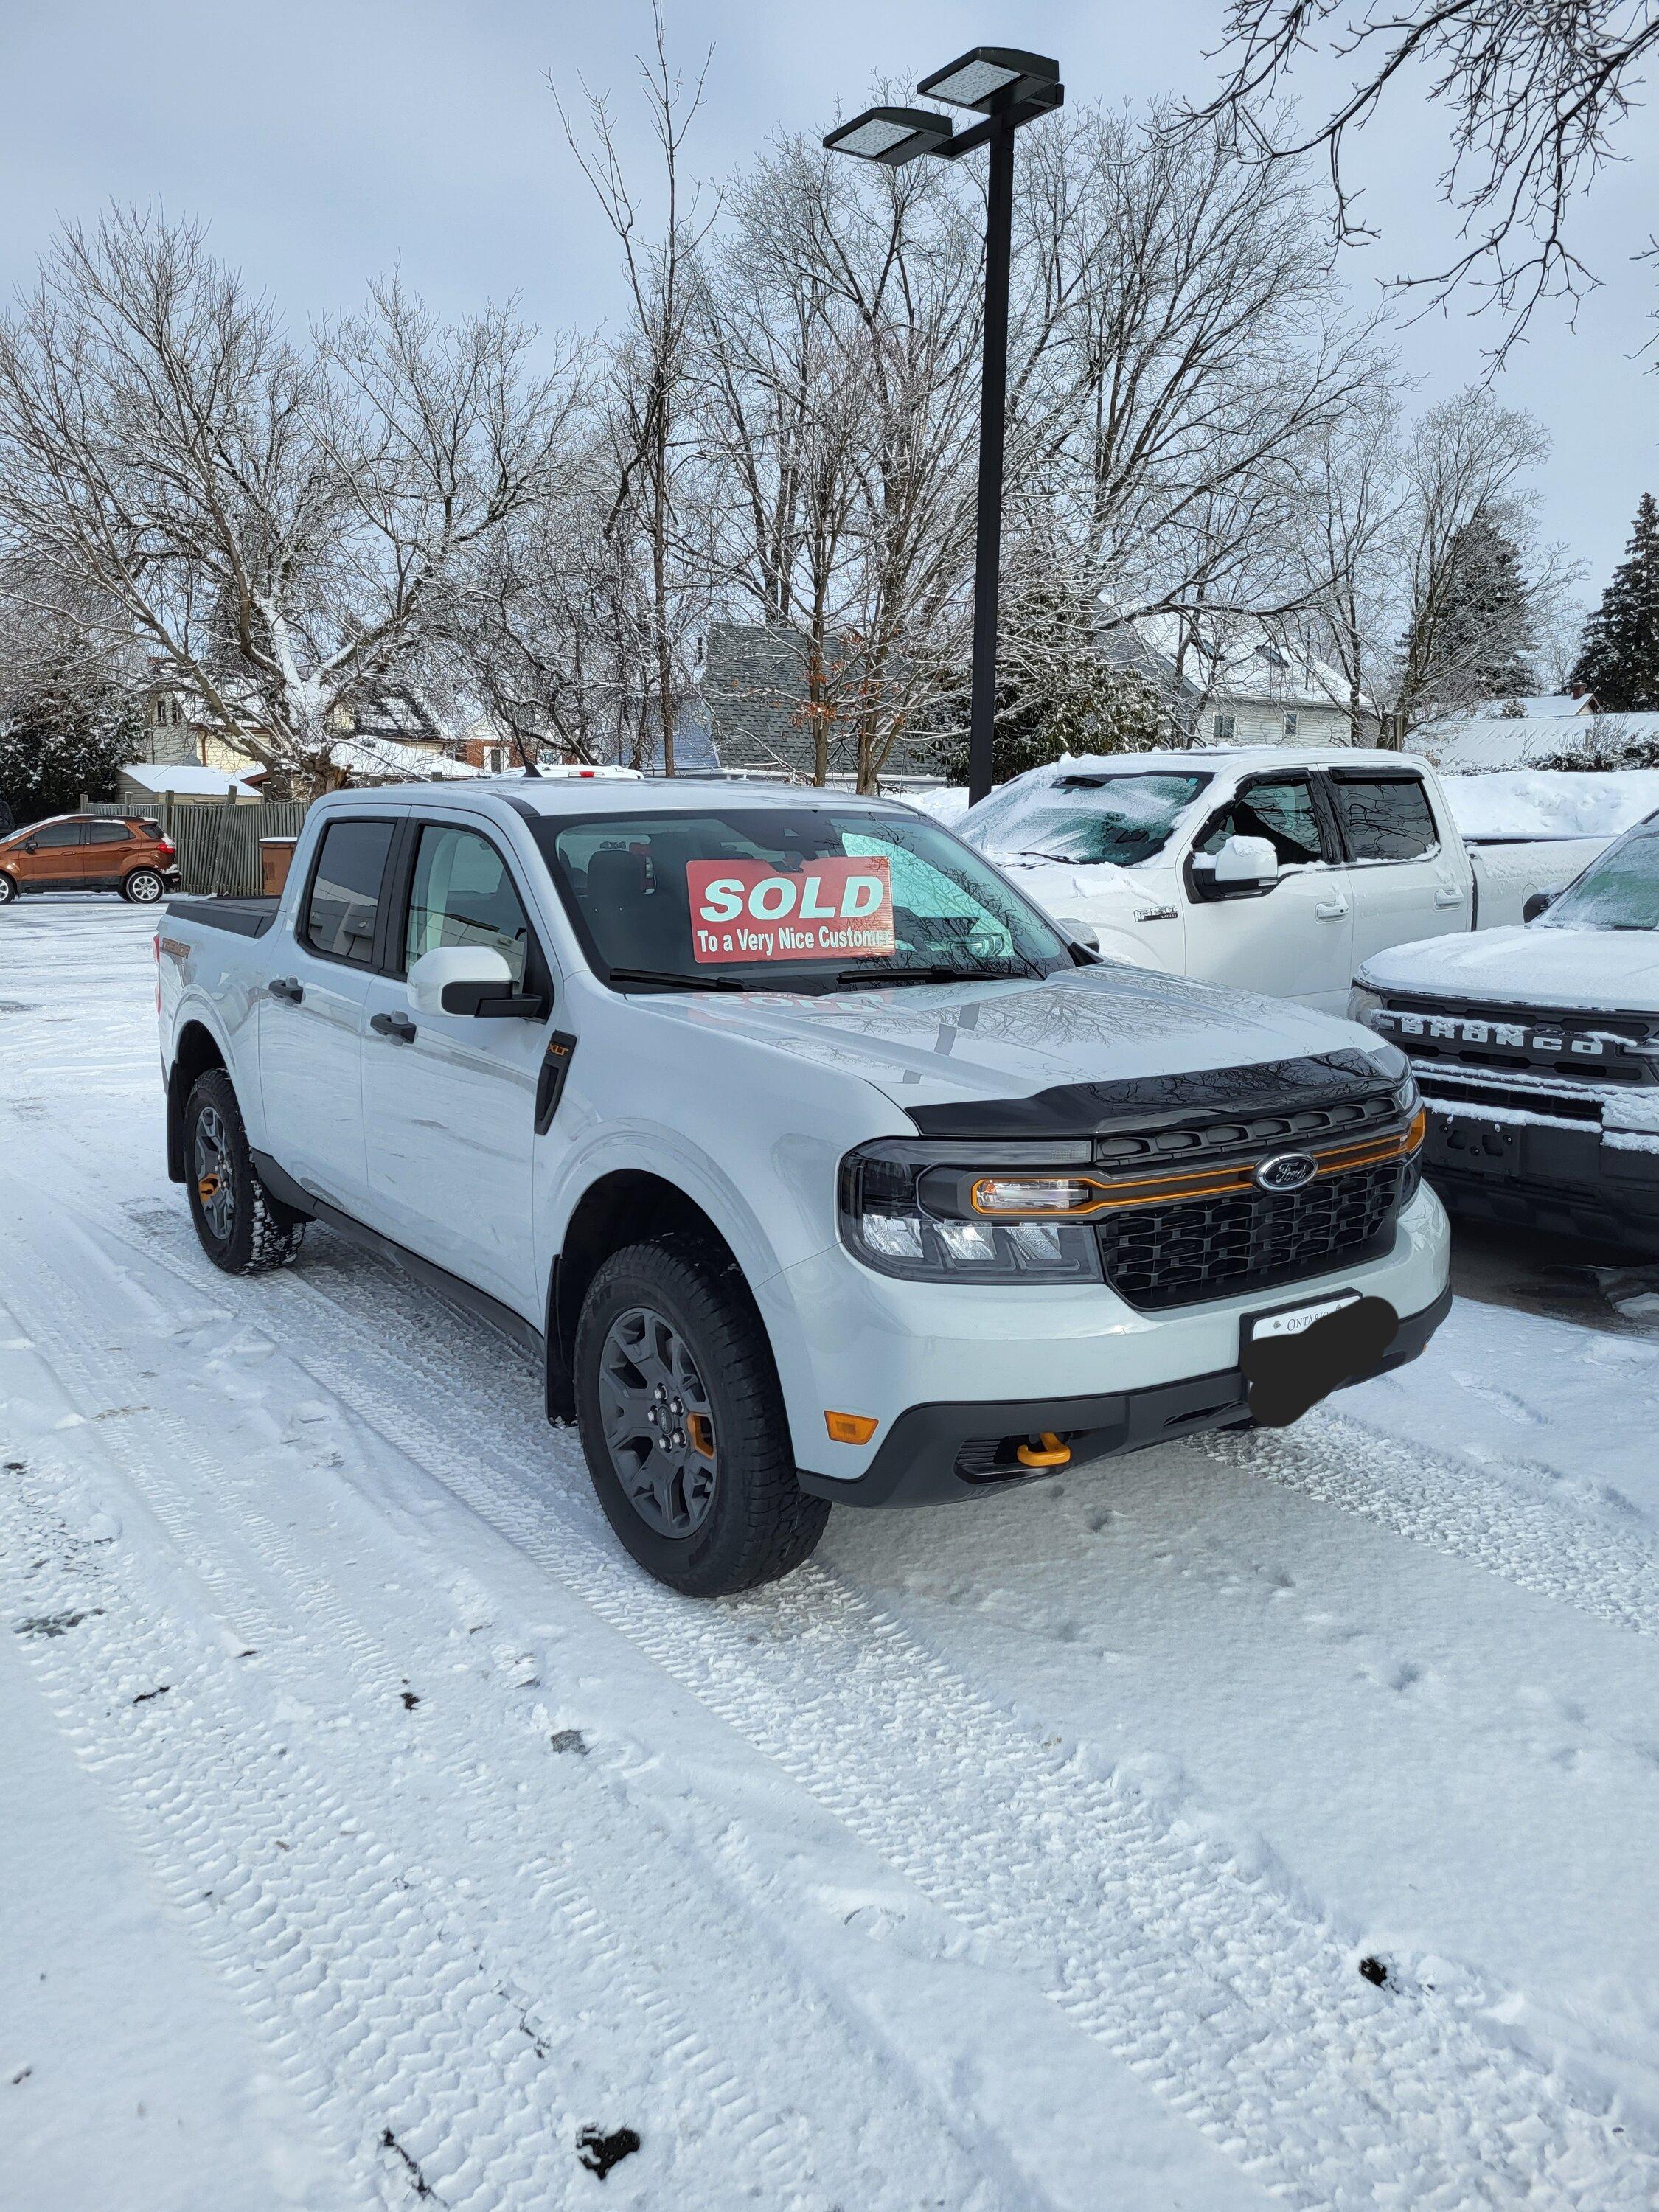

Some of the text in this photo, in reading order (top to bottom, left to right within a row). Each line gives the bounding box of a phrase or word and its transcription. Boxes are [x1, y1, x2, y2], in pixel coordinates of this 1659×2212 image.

[700, 876, 884, 922] SOLD
[697, 925, 891, 956] To a Very Nice Customer
[547, 1043, 569, 1056] XLT
[1401, 1018, 1603, 1055] BRONCO
[1275, 1161, 1307, 1183] Ford
